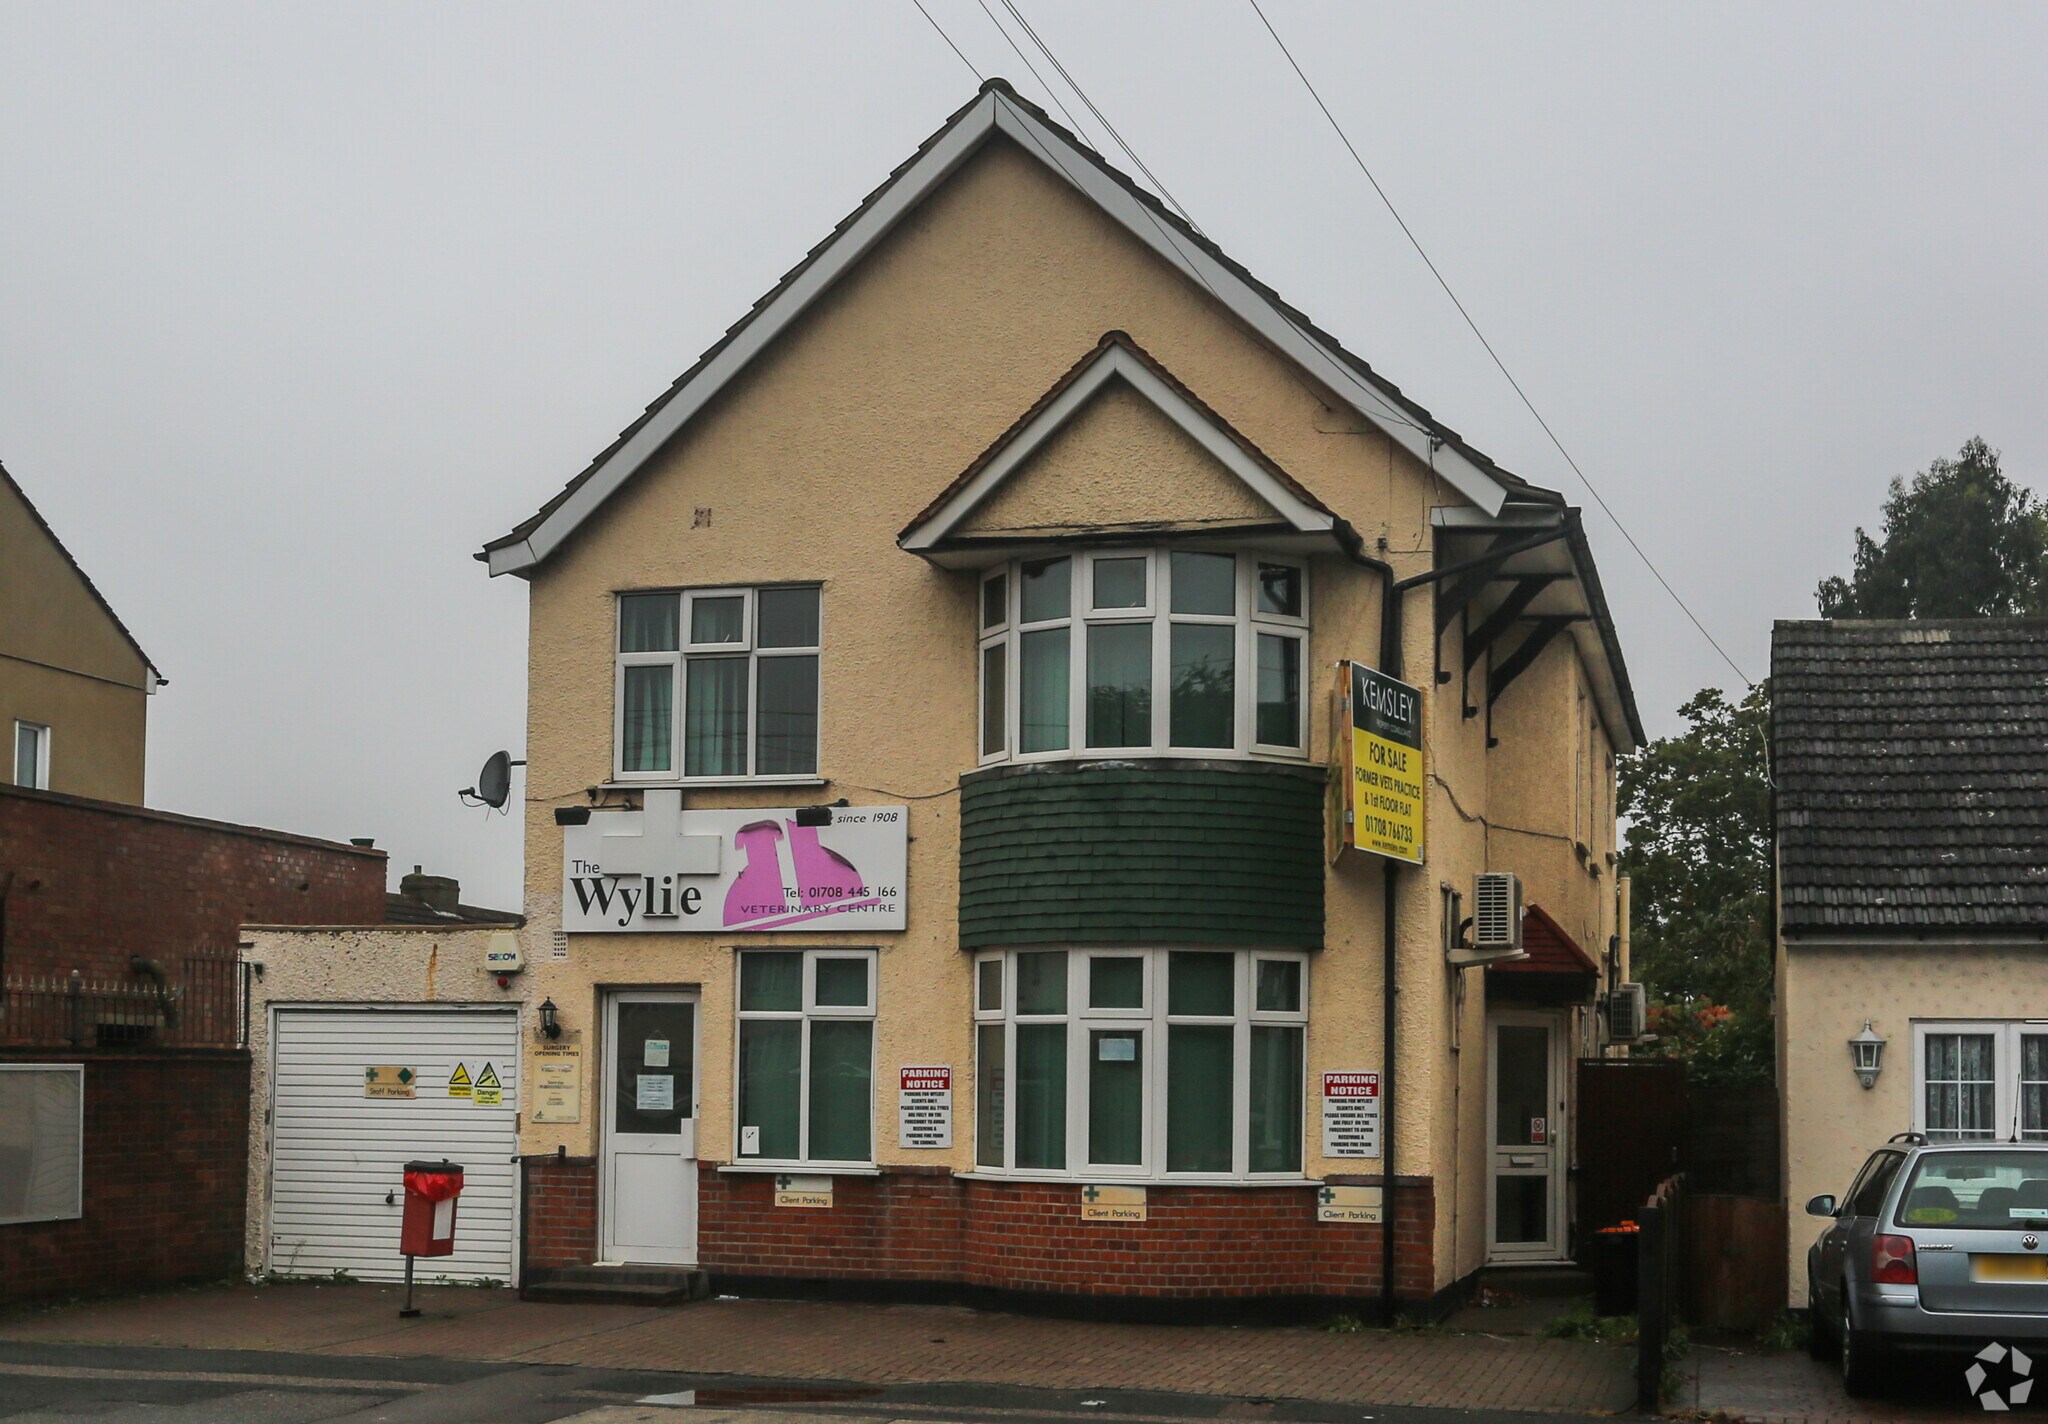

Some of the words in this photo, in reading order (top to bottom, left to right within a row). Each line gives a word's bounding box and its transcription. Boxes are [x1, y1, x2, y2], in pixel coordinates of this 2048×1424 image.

[1361, 677, 1414, 724] KEMSLEY
[1370, 742, 1386, 766] FOR
[1388, 748, 1406, 773] SALE
[1355, 766, 1379, 786] FORMER
[1380, 774, 1392, 791] VETS
[1394, 779, 1420, 800] PRACTICE
[1364, 792, 1369, 805] &
[1370, 793, 1378, 808] 1st
[1380, 796, 1398, 813] FLOOR
[1400, 802, 1412, 816] FLAT
[837, 814, 867, 824] since
[872, 812, 898, 822] 1908
[1366, 814, 1386, 836] 01708
[1388, 821, 1413, 843] 766733
[572, 860, 600, 874] The
[784, 888, 804, 898] Tel:
[809, 886, 843, 898] 01708
[848, 886, 870, 898] 445
[877, 886, 897, 897] 166
[570, 876, 702, 927] Wylie
[740, 905, 831, 914] VETERINARY
[837, 903, 896, 914] CENTRE
[488, 953, 516, 962] SECOM
[902, 1069, 948, 1078] PARKING
[906, 1080, 944, 1088] NOTICE
[1326, 1075, 1377, 1084] PARKING
[369, 1087, 385, 1096] Staff
[387, 1088, 410, 1097] Parking
[1331, 1086, 1372, 1095] NOTICE
[780, 1196, 800, 1204] Client
[802, 1196, 828, 1206] Parking
[1088, 1208, 1109, 1217] Client
[1112, 1210, 1140, 1219] Parking
[1324, 1210, 1345, 1218] Client
[1348, 1211, 1376, 1220] Parking
